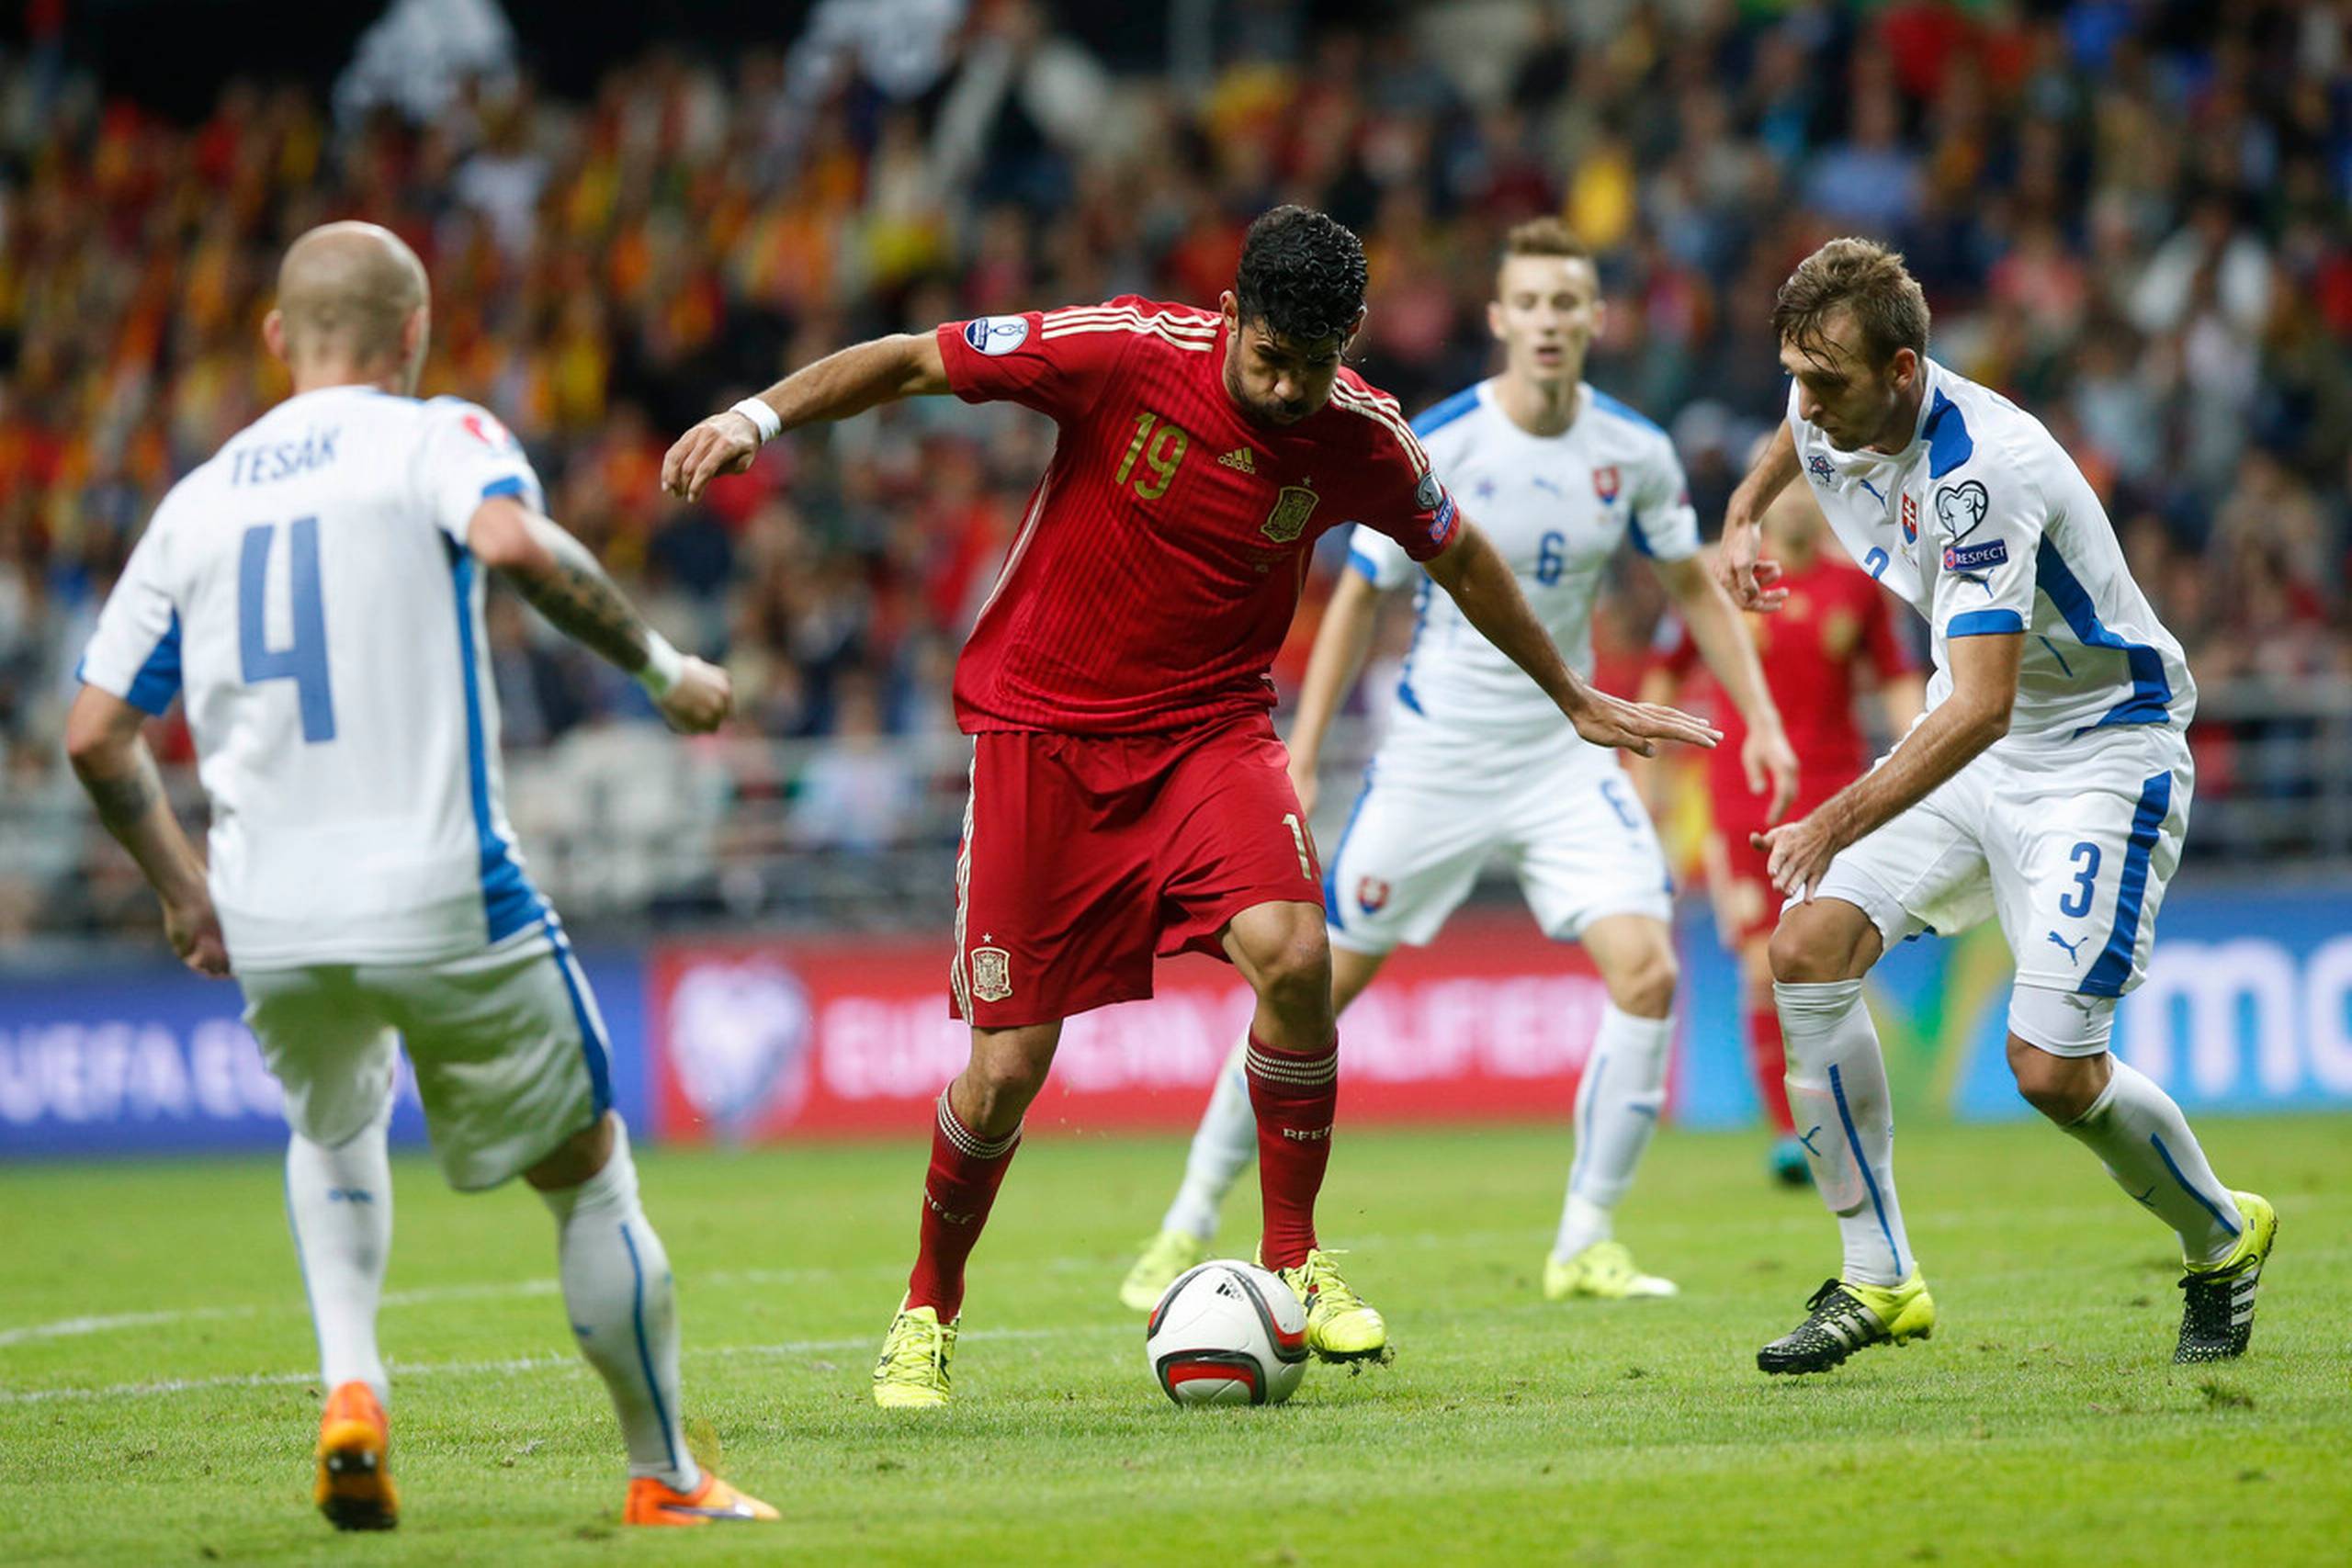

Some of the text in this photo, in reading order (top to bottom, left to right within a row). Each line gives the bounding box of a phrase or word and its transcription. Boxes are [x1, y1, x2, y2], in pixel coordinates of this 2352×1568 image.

[232, 424, 342, 488] TESÁK
[1115, 412, 1189, 501] 19
[1217, 452, 1257, 475] adidas
[1536, 528, 1566, 587] 6
[1955, 545, 2006, 565] RESPECT
[238, 516, 337, 743] 4
[2059, 840, 2102, 919] 3
